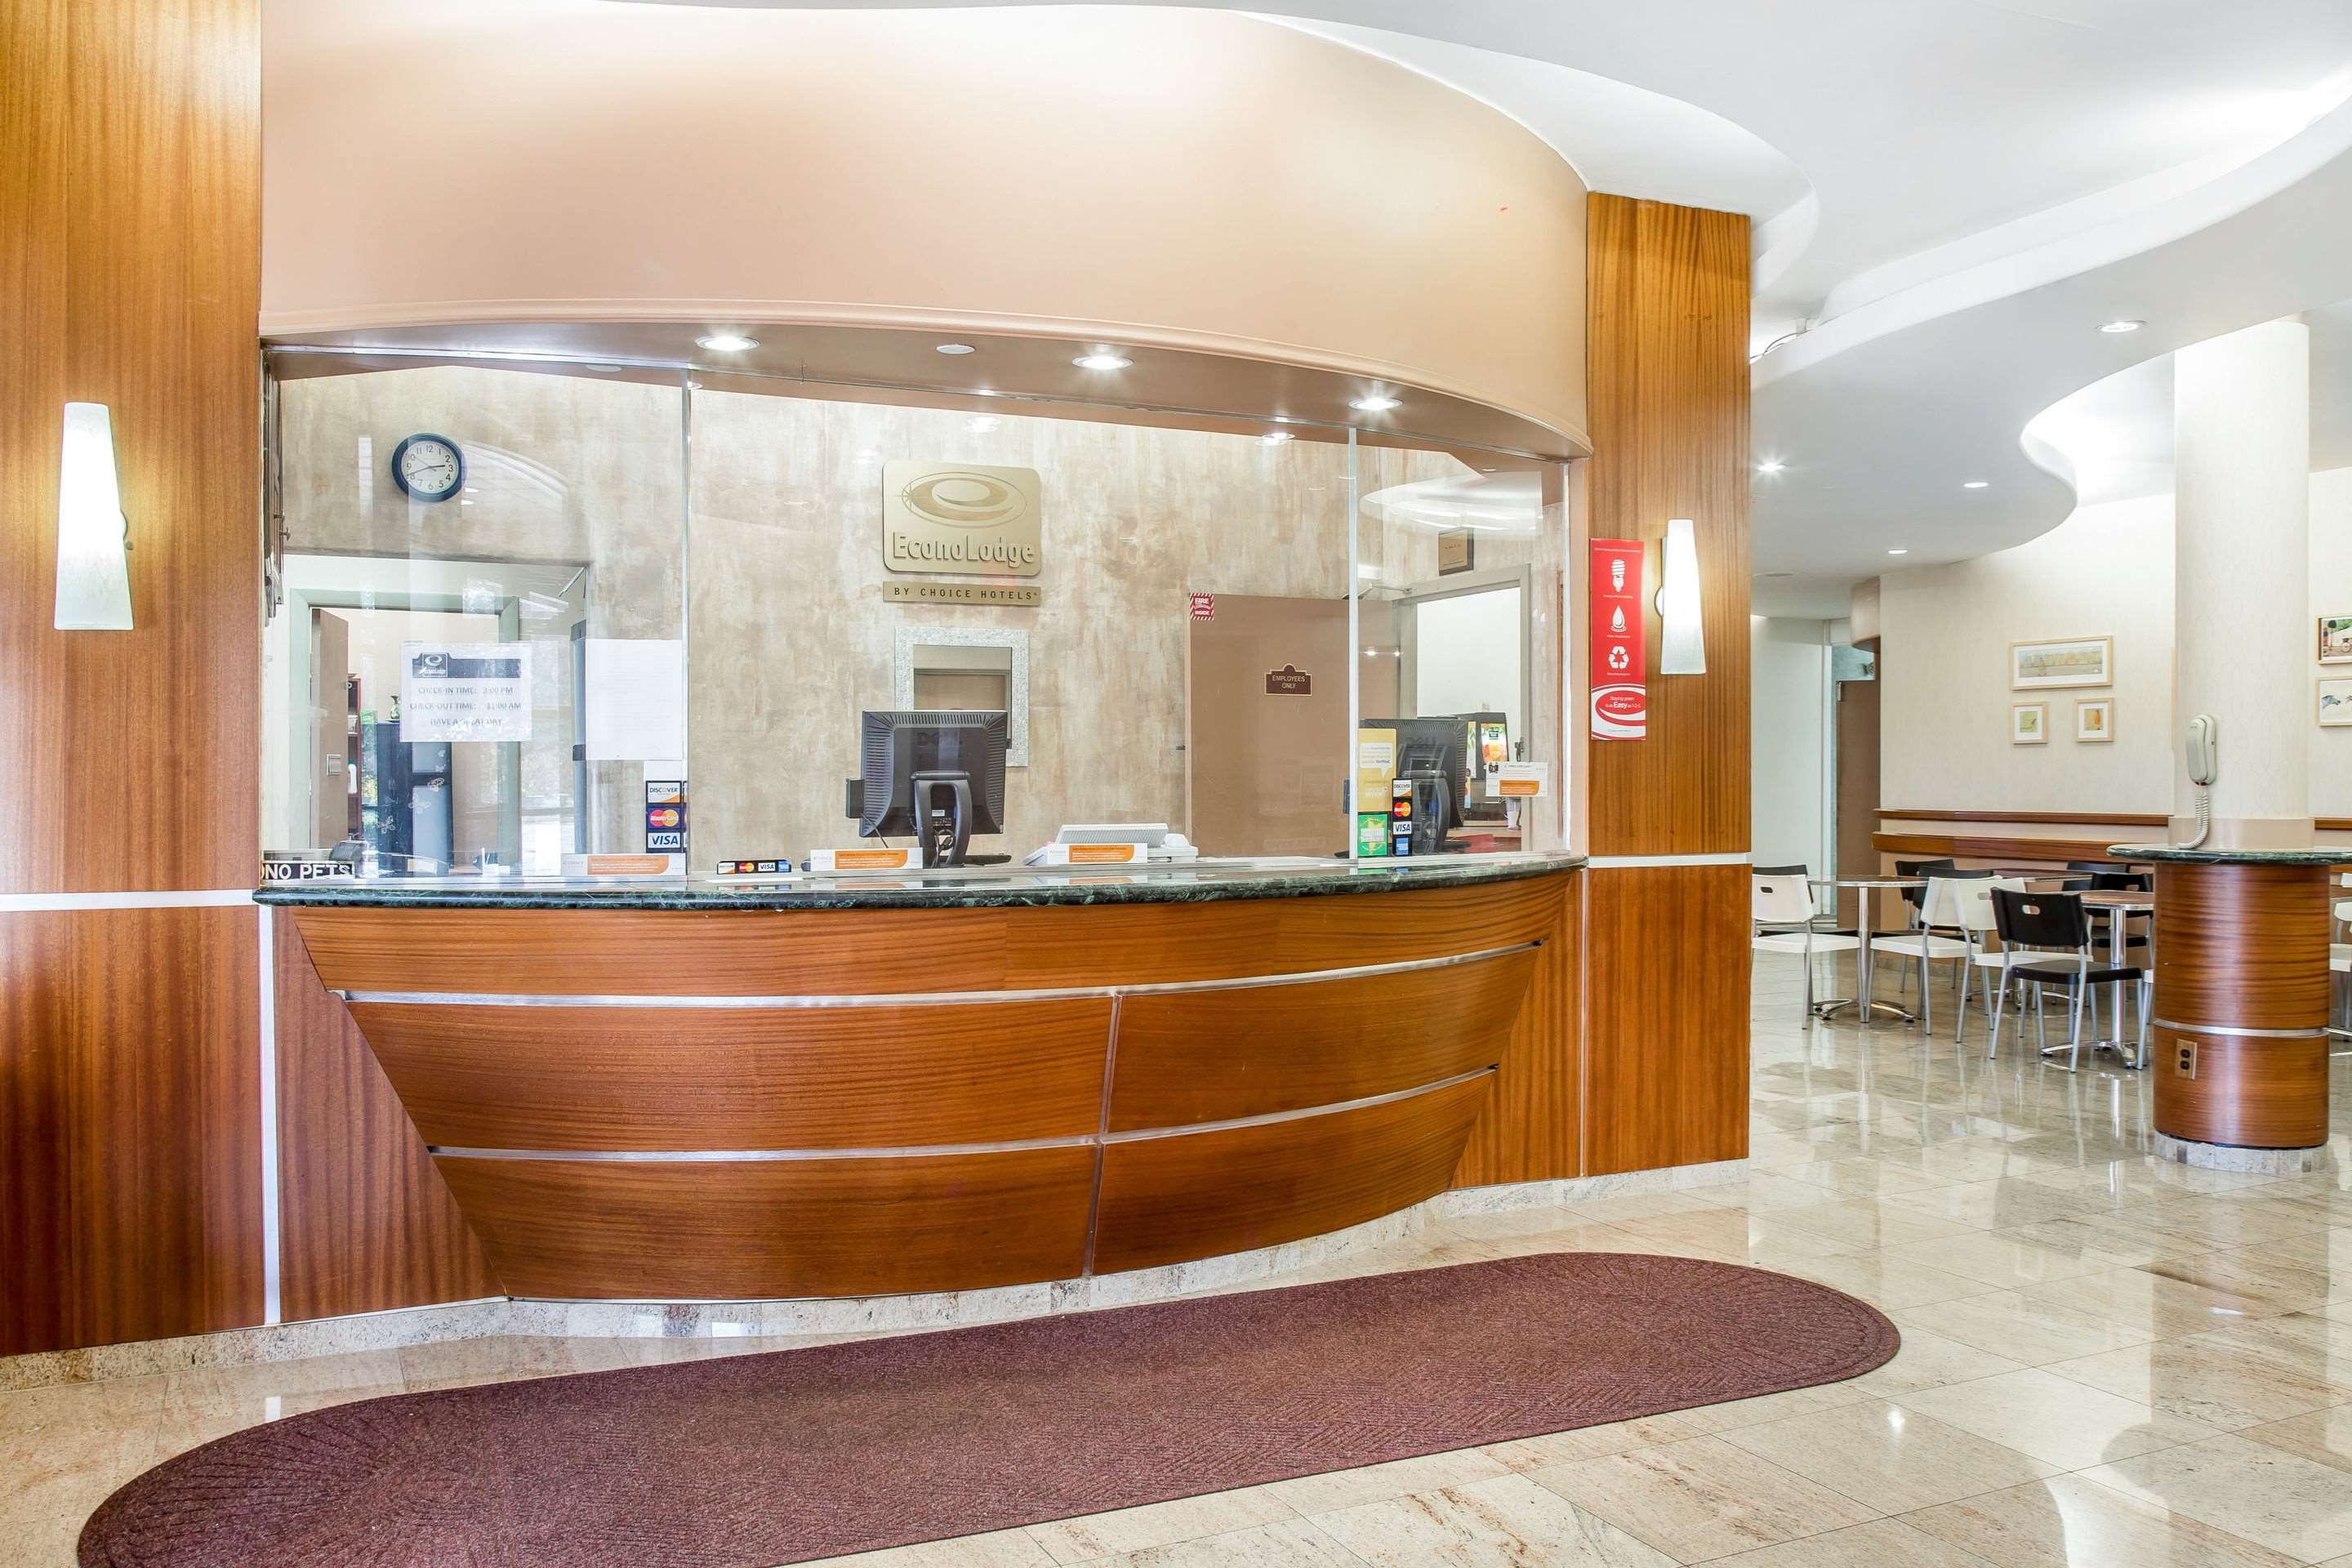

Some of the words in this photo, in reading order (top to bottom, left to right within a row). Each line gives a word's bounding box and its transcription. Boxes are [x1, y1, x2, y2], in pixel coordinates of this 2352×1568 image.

[425, 444, 434, 453] 12
[445, 454, 451, 463] 2
[406, 462, 412, 470] 9
[448, 464, 454, 472] 3
[445, 474, 451, 482] 4
[417, 479, 423, 487] 7
[428, 482, 434, 491] 6
[439, 480, 444, 488] 5
[894, 587, 910, 596] BY
[920, 587, 972, 599] CHOICE
[981, 590, 1032, 600] HOTELS
[1272, 675, 1306, 683] EMPLOYEES
[417, 686, 454, 695] CHECK-IN
[501, 686, 514, 695] PM
[507, 702, 522, 710] AM
[1613, 701, 1628, 709] Easy
[430, 718, 452, 726] HAVE
[1395, 823, 1411, 832] VISA
[652, 835, 679, 845] VISA
[265, 863, 292, 880] NO
[300, 863, 351, 880] PETS
